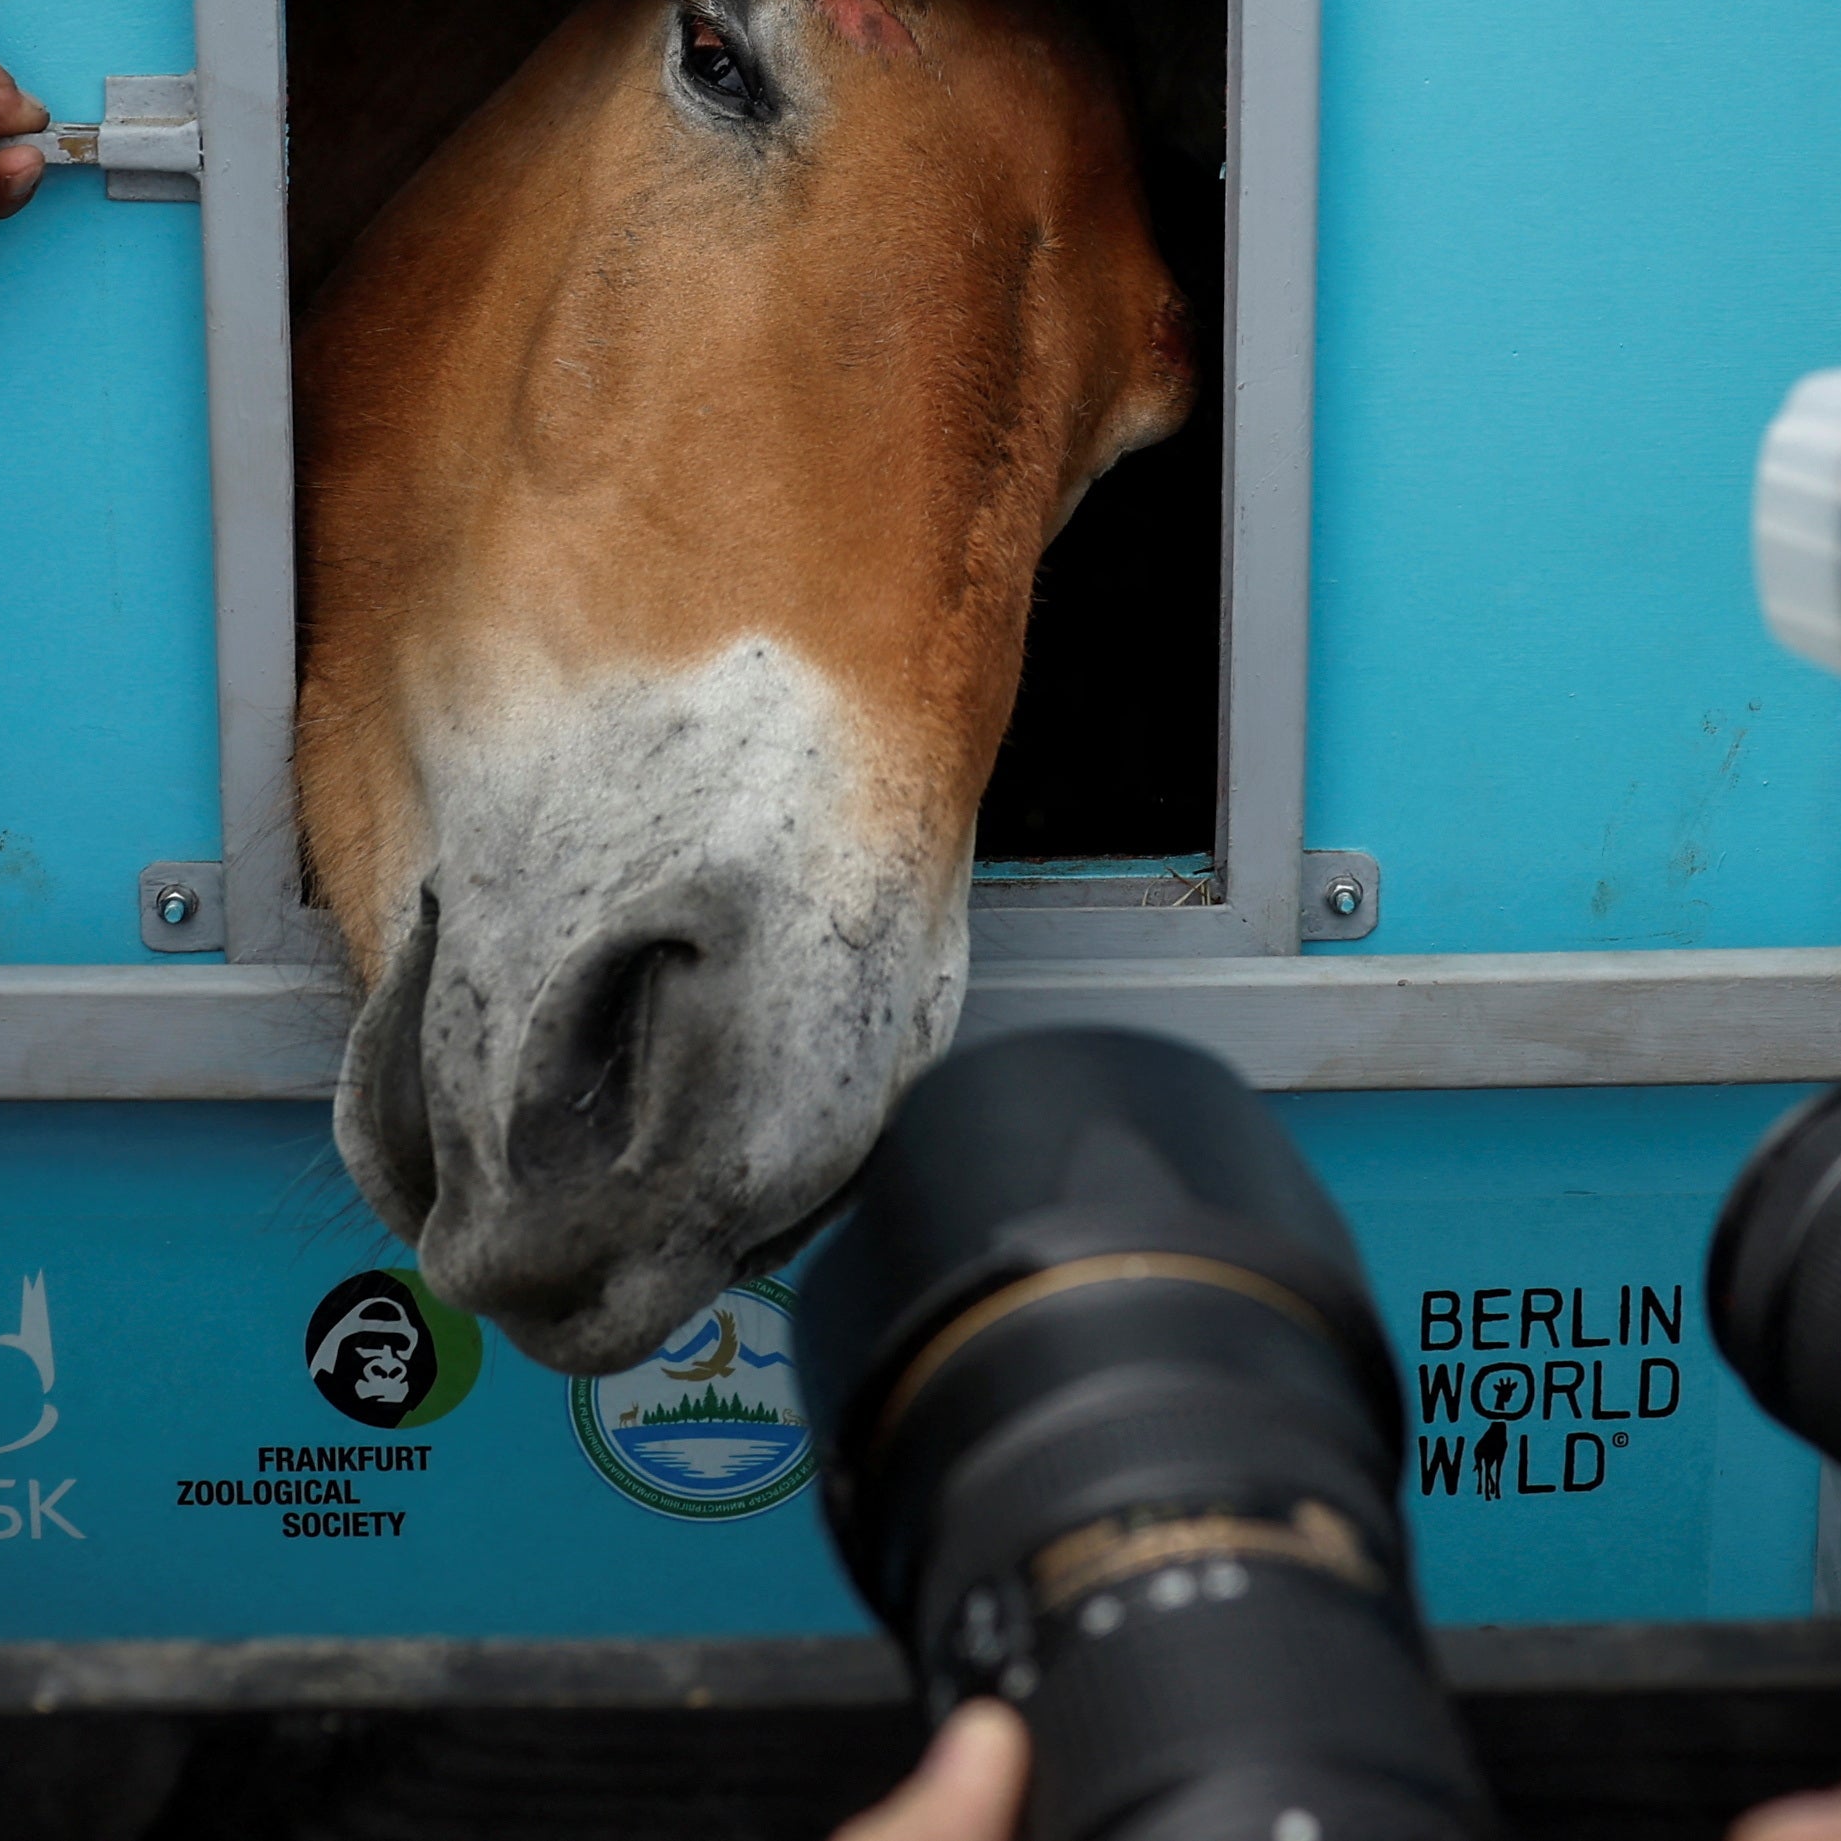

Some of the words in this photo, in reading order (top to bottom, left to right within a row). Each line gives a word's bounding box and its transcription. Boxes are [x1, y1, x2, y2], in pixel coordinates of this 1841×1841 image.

[1420, 1284, 1682, 1352] BERLIN
[1418, 1357, 1680, 1425] WORLD
[258, 1445, 433, 1473] FRANKFURT
[176, 1478, 361, 1507] ZOOLOGICAL
[281, 1510, 407, 1538] SOCIETY
